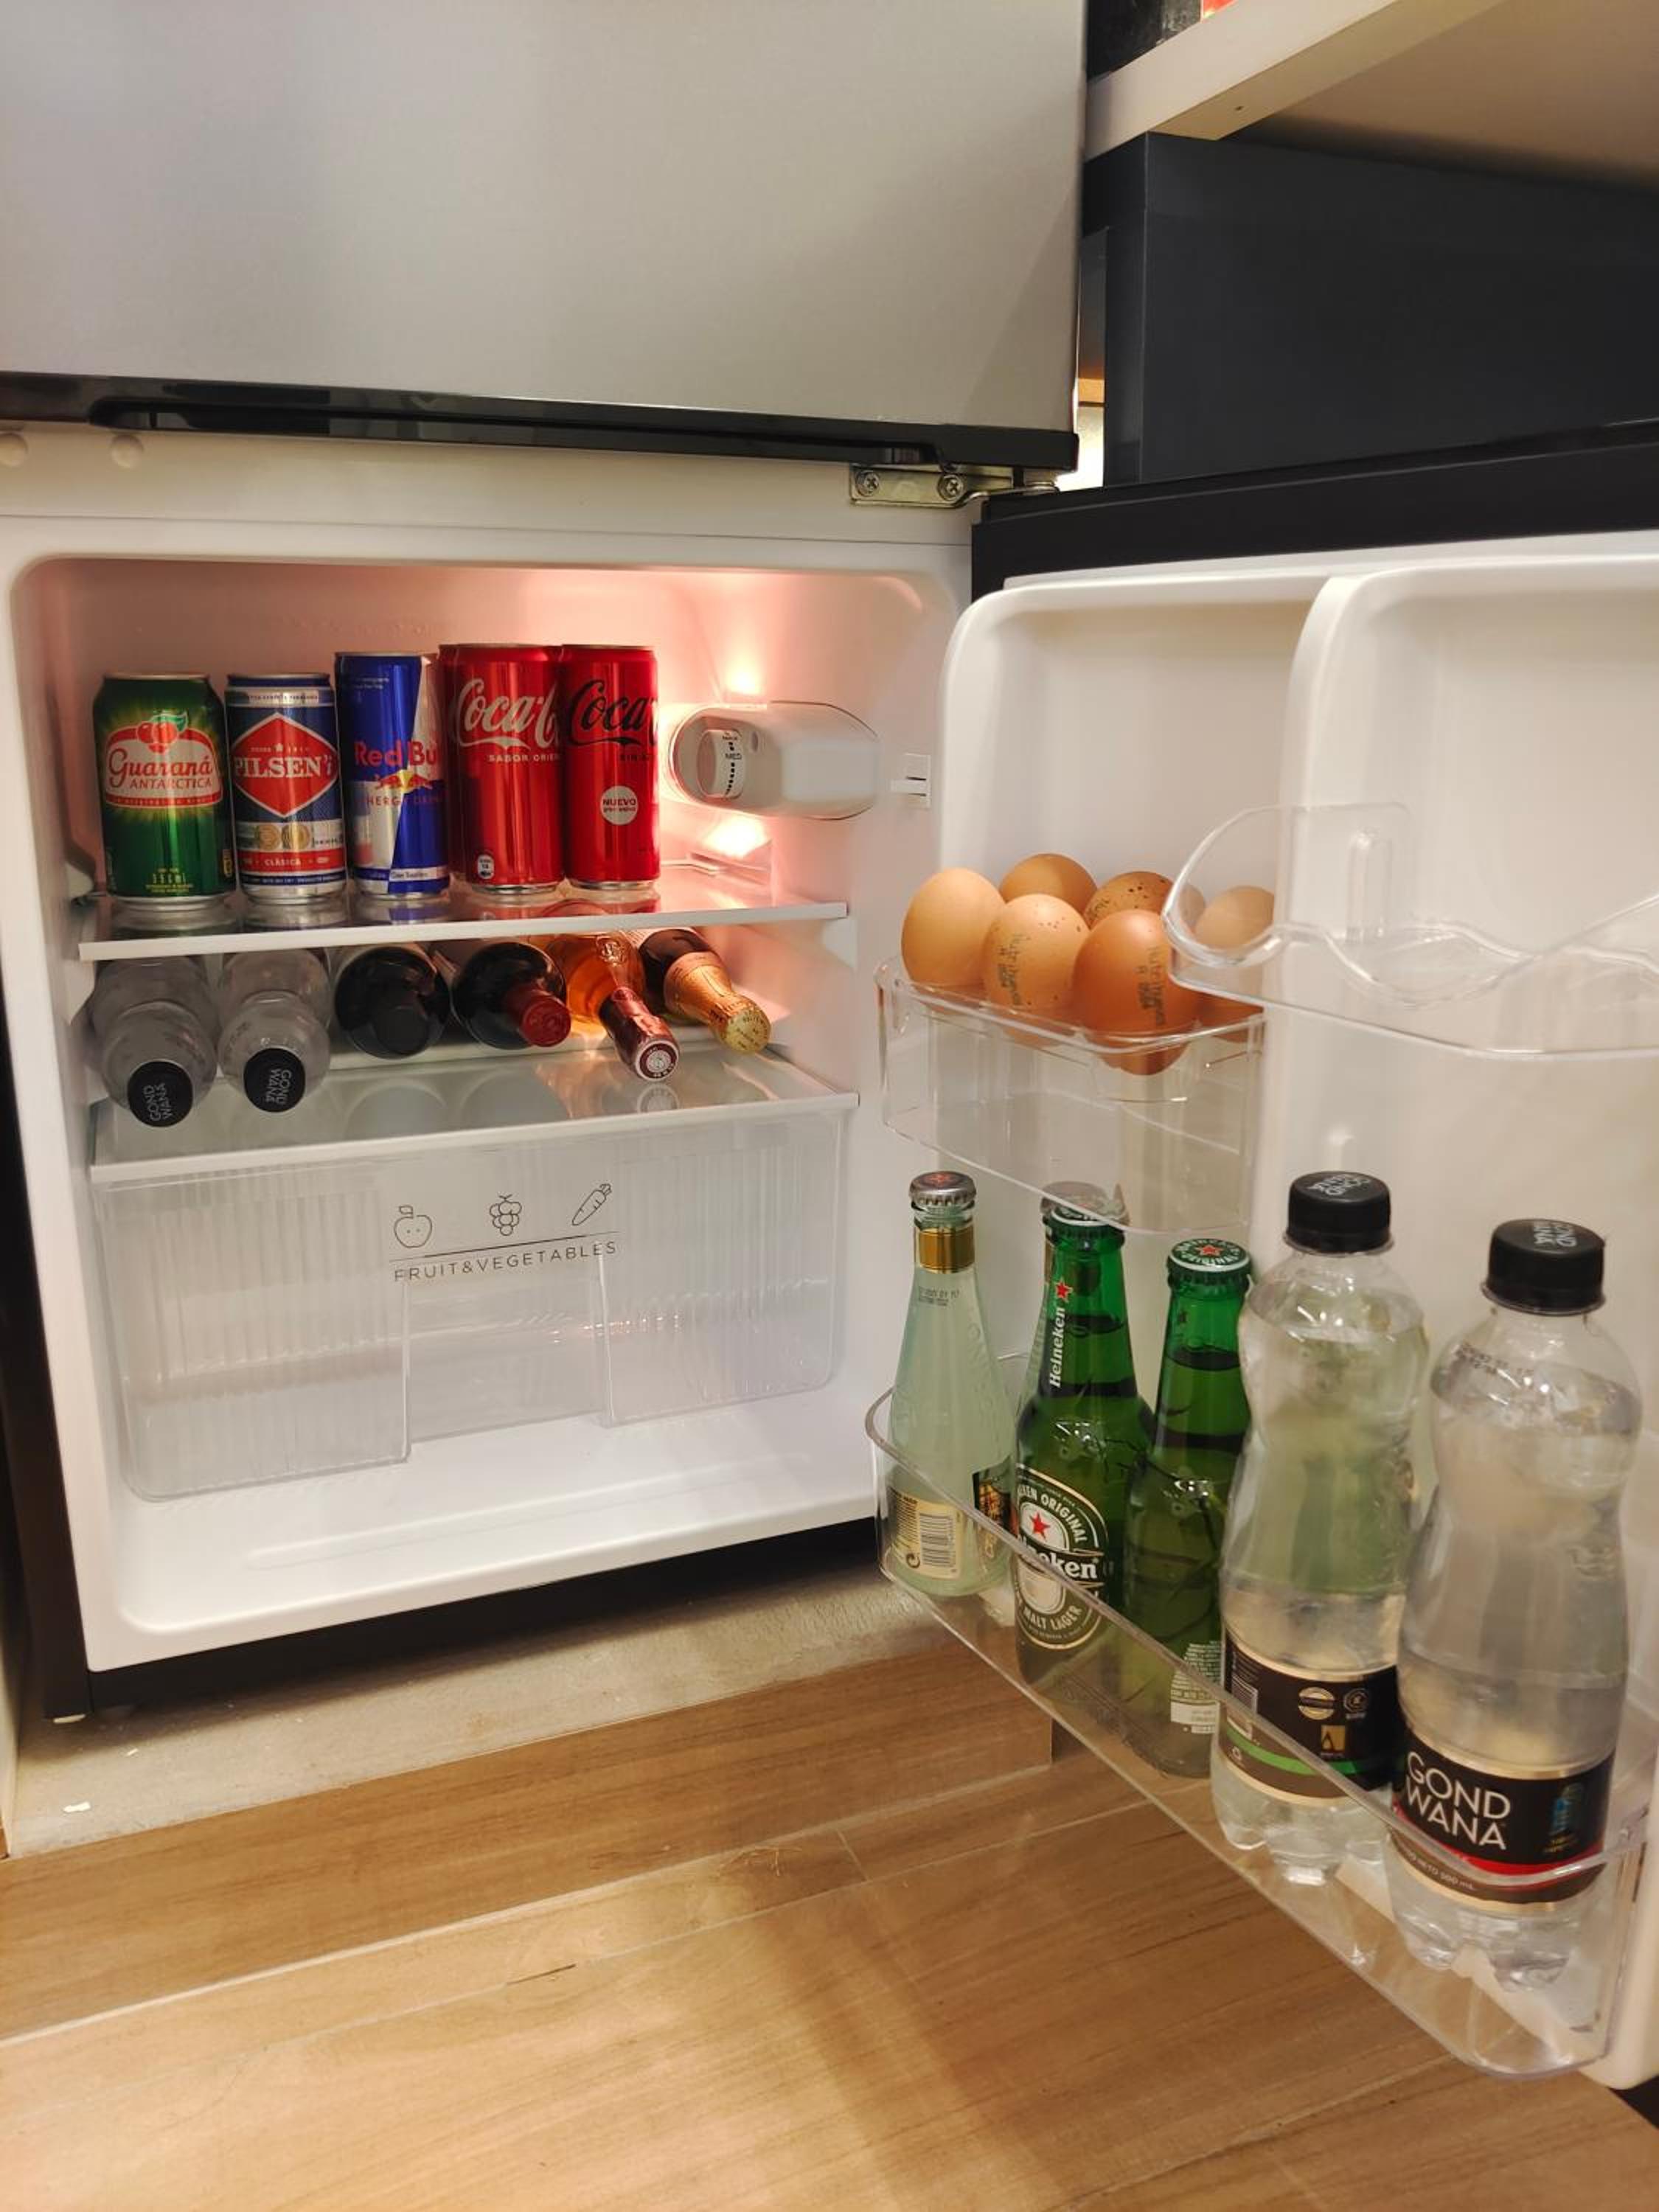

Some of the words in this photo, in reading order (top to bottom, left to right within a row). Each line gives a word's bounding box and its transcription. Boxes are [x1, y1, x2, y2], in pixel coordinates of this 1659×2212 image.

[108, 748, 212, 787] Guaraná
[354, 740, 403, 768] Red
[409, 740, 437, 767] Bu
[490, 754, 529, 762] SABOR
[143, 1085, 161, 1121] GOND
[276, 1069, 292, 1105] GOND
[394, 1241, 616, 1282] FRUIT&VEGETABLES
[1048, 1307, 1065, 1388] Heineken
[1040, 1493, 1088, 1544] ORIGINAL
[1049, 1605, 1083, 1631] LAGER
[1407, 1751, 1512, 1820] GOND
[1405, 1774, 1506, 1851] WANA
